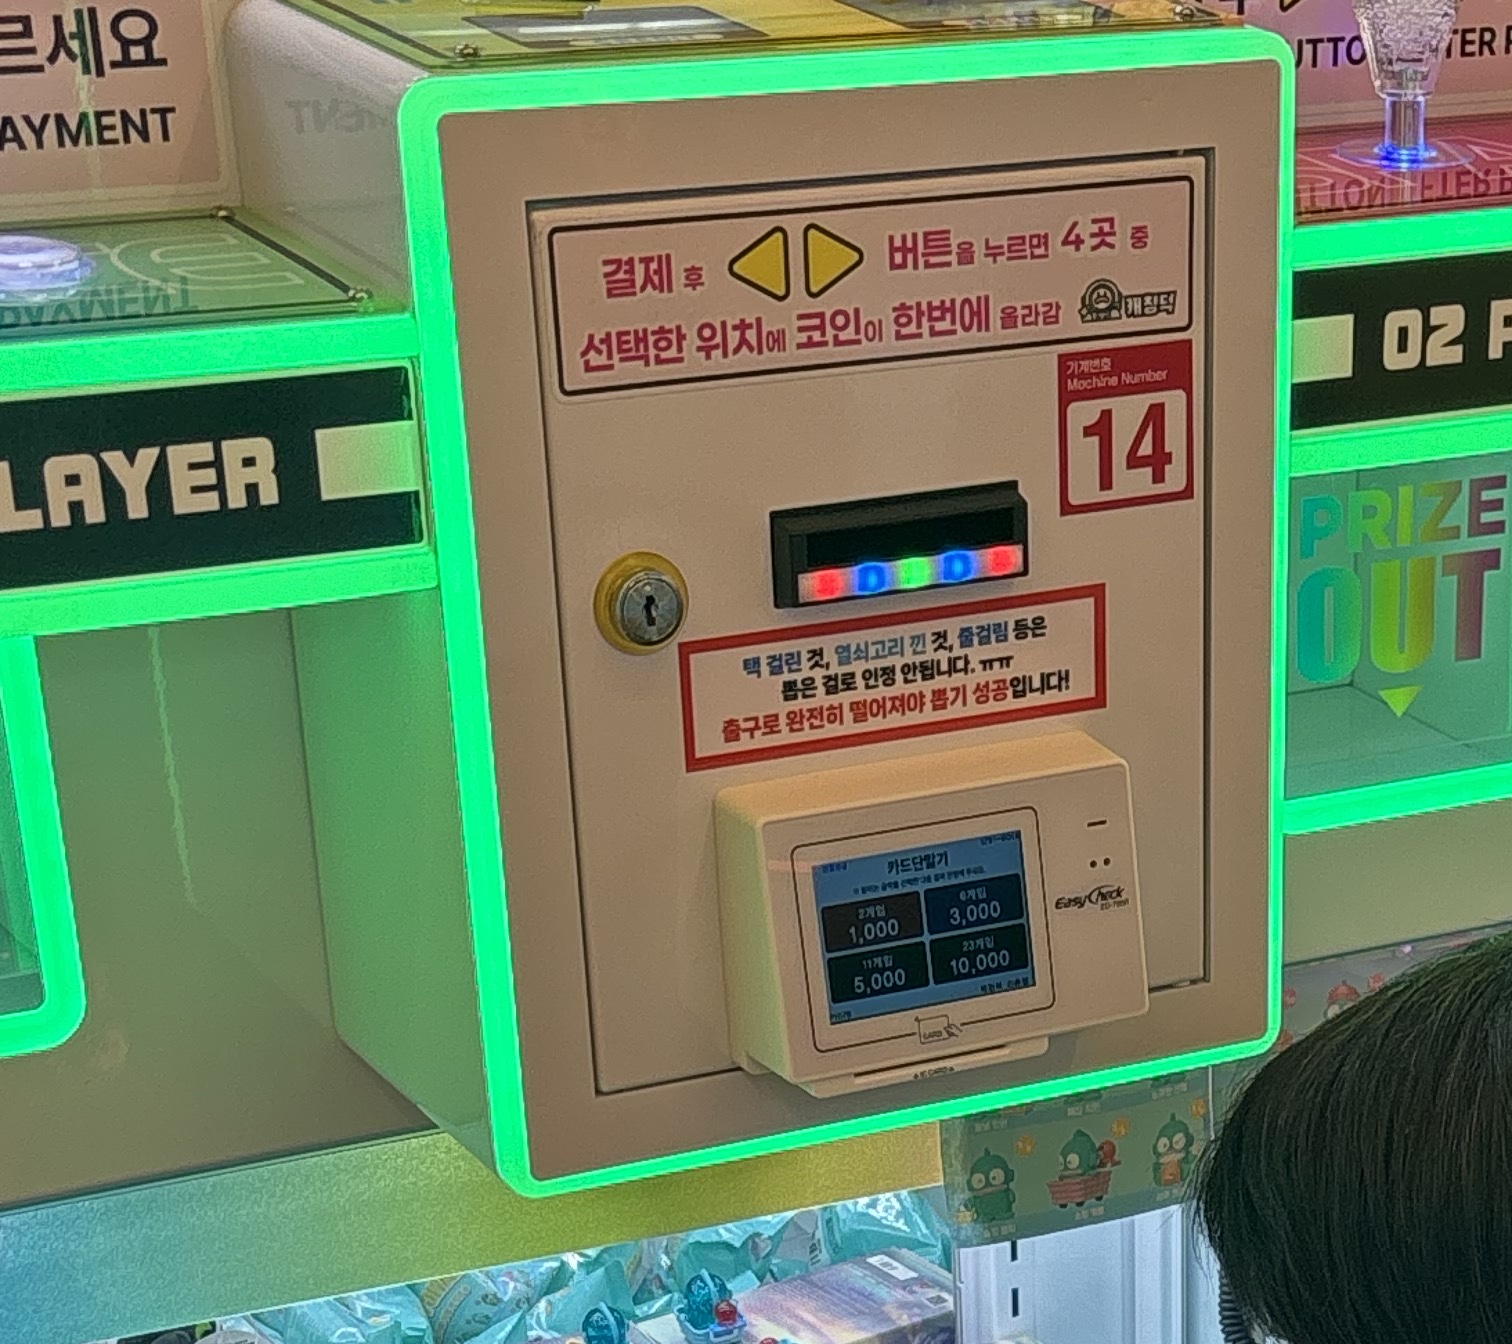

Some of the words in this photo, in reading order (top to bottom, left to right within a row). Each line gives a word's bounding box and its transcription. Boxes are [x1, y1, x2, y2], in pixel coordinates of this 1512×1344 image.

[1445, 26, 1496, 59] TER
[602, 253, 673, 300] 결제
[683, 264, 704, 291] 후
[888, 228, 976, 272] 버튼을
[983, 232, 1050, 264] 누르면
[1129, 225, 1149, 251] 중
[580, 325, 686, 374] 선택한
[696, 315, 786, 364] 위치에
[795, 306, 883, 350] 코인이
[891, 294, 991, 340] 한번에
[999, 302, 1061, 331] 올라감
[1382, 305, 1465, 371] 02
[1121, 368, 1168, 384] Number
[1083, 402, 1173, 492] 14
[1300, 474, 1508, 560] PRIZE
[1297, 547, 1501, 684] OUT
[861, 664, 897, 690] 인정
[949, 902, 1000, 926] 3,000
[848, 920, 899, 945] 1,000
[949, 949, 1010, 977] 10,000
[853, 968, 906, 995] 5,000
